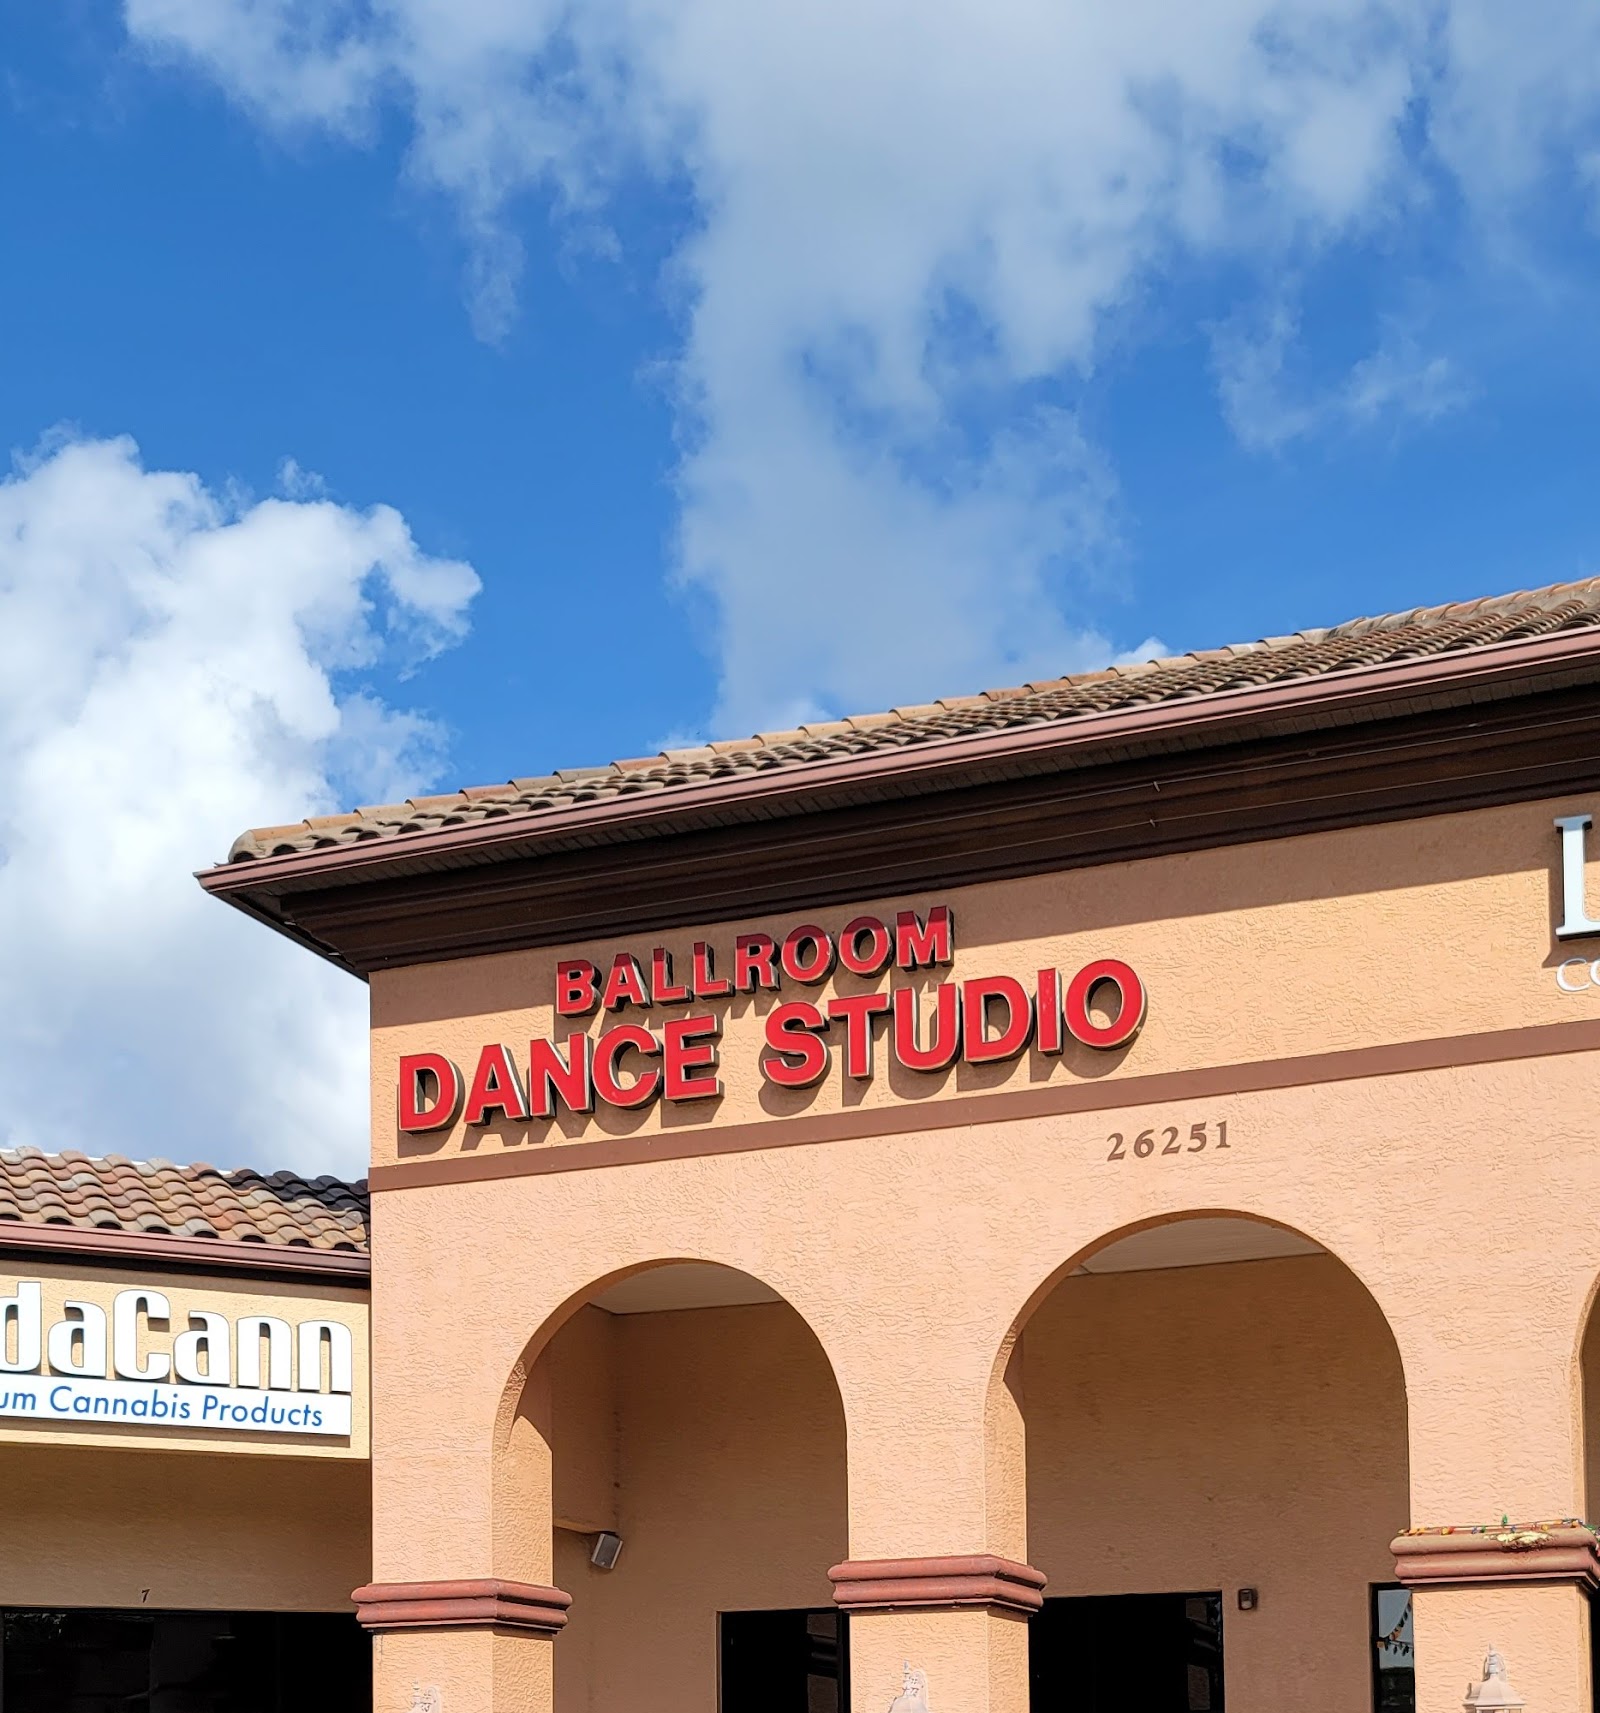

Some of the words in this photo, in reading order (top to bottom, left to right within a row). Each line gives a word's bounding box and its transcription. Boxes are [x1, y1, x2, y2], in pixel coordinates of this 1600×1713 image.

[556, 905, 953, 1017] BALLROOM
[399, 1013, 721, 1133] DANCE
[762, 957, 1146, 1088] STUDIO
[1106, 1120, 1232, 1162] 26251
[49, 1385, 191, 1420] Cannabis
[202, 1394, 323, 1428] Products
[141, 1588, 151, 1603] 7
